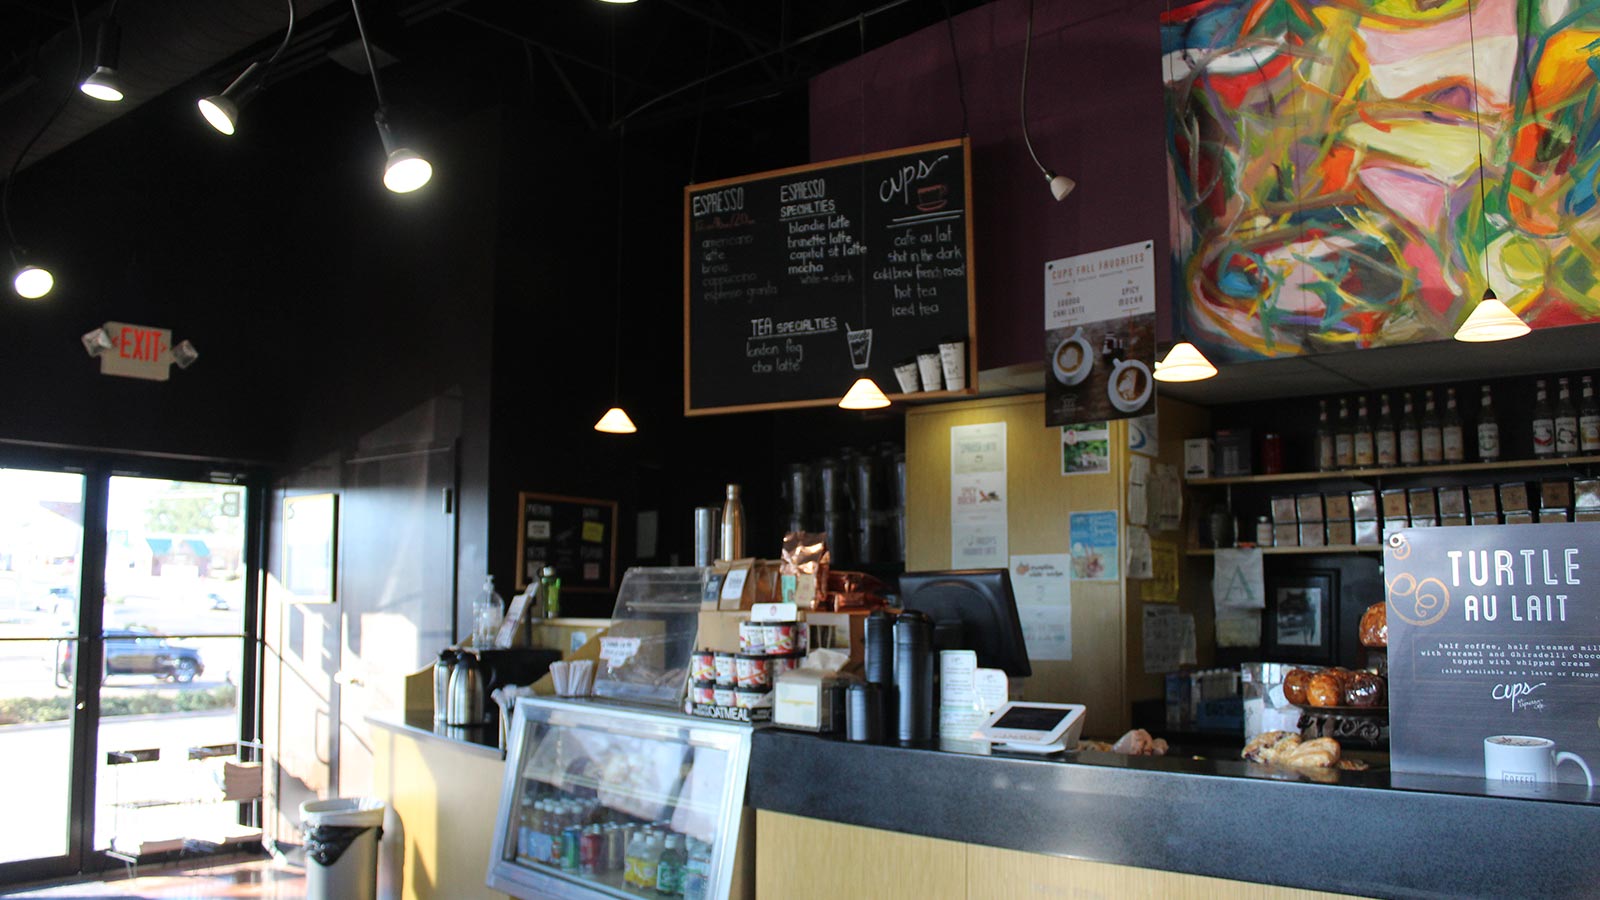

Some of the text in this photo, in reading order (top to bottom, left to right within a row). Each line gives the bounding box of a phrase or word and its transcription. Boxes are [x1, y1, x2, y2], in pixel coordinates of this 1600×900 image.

[879, 154, 949, 205] cups
[780, 178, 825, 203] ESPRESSO
[692, 187, 744, 216] ESPRESSO
[780, 199, 836, 217] SPECIALTIES
[789, 214, 850, 234] blondie latte
[920, 233, 932, 243] au
[935, 224, 952, 243] lait
[787, 230, 852, 249] brunette latte
[789, 246, 824, 265] capitol
[842, 241, 867, 256] latte
[887, 249, 907, 263] shot
[936, 245, 962, 261] dark
[788, 261, 824, 275] mocha
[916, 263, 942, 280] french
[943, 261, 965, 278] roast
[1052, 268, 1072, 280] CUPS
[1076, 264, 1095, 275] FALL
[1099, 253, 1144, 270] FAVORITES
[894, 283, 938, 300] hot tea
[892, 302, 940, 318] iced tea
[751, 316, 837, 336] TEA SPECIALTIES
[120, 326, 162, 363] EXIT
[785, 338, 803, 362] fog
[752, 357, 801, 373] chai latte
[1447, 548, 1580, 587] TURTLE
[1464, 595, 1567, 621] AU LAIT
[1438, 642, 1459, 650] half
[1464, 643, 1501, 651] coffee,
[1507, 643, 1529, 651] half
[1535, 644, 1574, 652] steamed
[1446, 650, 1483, 658] caramel
[1488, 650, 1505, 658] and
[1510, 651, 1567, 660] Ghiradelli
[1452, 657, 1484, 666] topped
[1488, 658, 1511, 666] with
[1516, 659, 1556, 668] whipped
[1465, 668, 1504, 676] available
[1530, 669, 1553, 677] latte
[1491, 682, 1547, 713] cups
[708, 706, 750, 722] OATMEAL
[1503, 774, 1536, 785] COFFEE
